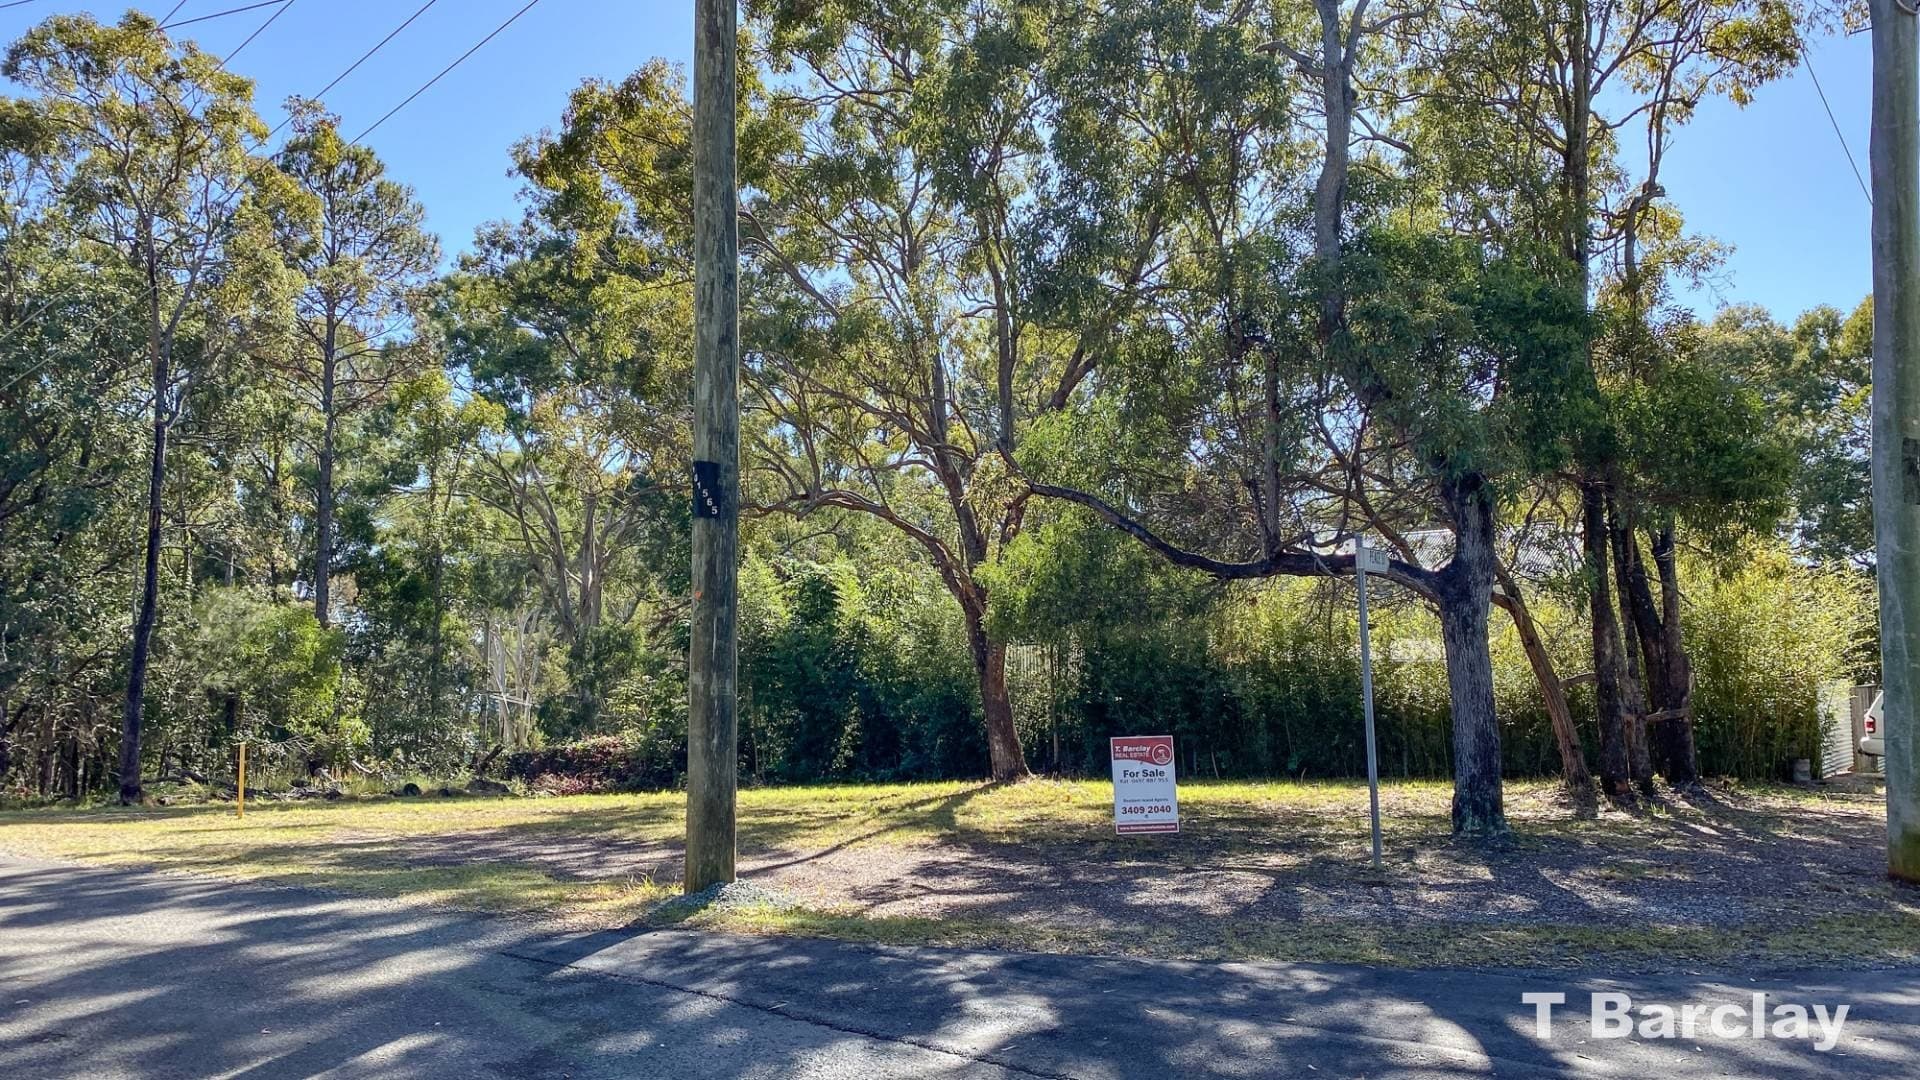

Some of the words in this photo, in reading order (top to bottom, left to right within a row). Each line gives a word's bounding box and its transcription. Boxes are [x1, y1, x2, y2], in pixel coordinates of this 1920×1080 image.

[1123, 769, 1140, 778] For
[1142, 769, 1165, 778] Sale
[1121, 806, 1145, 815] 3409
[1147, 805, 1172, 814] 2040
